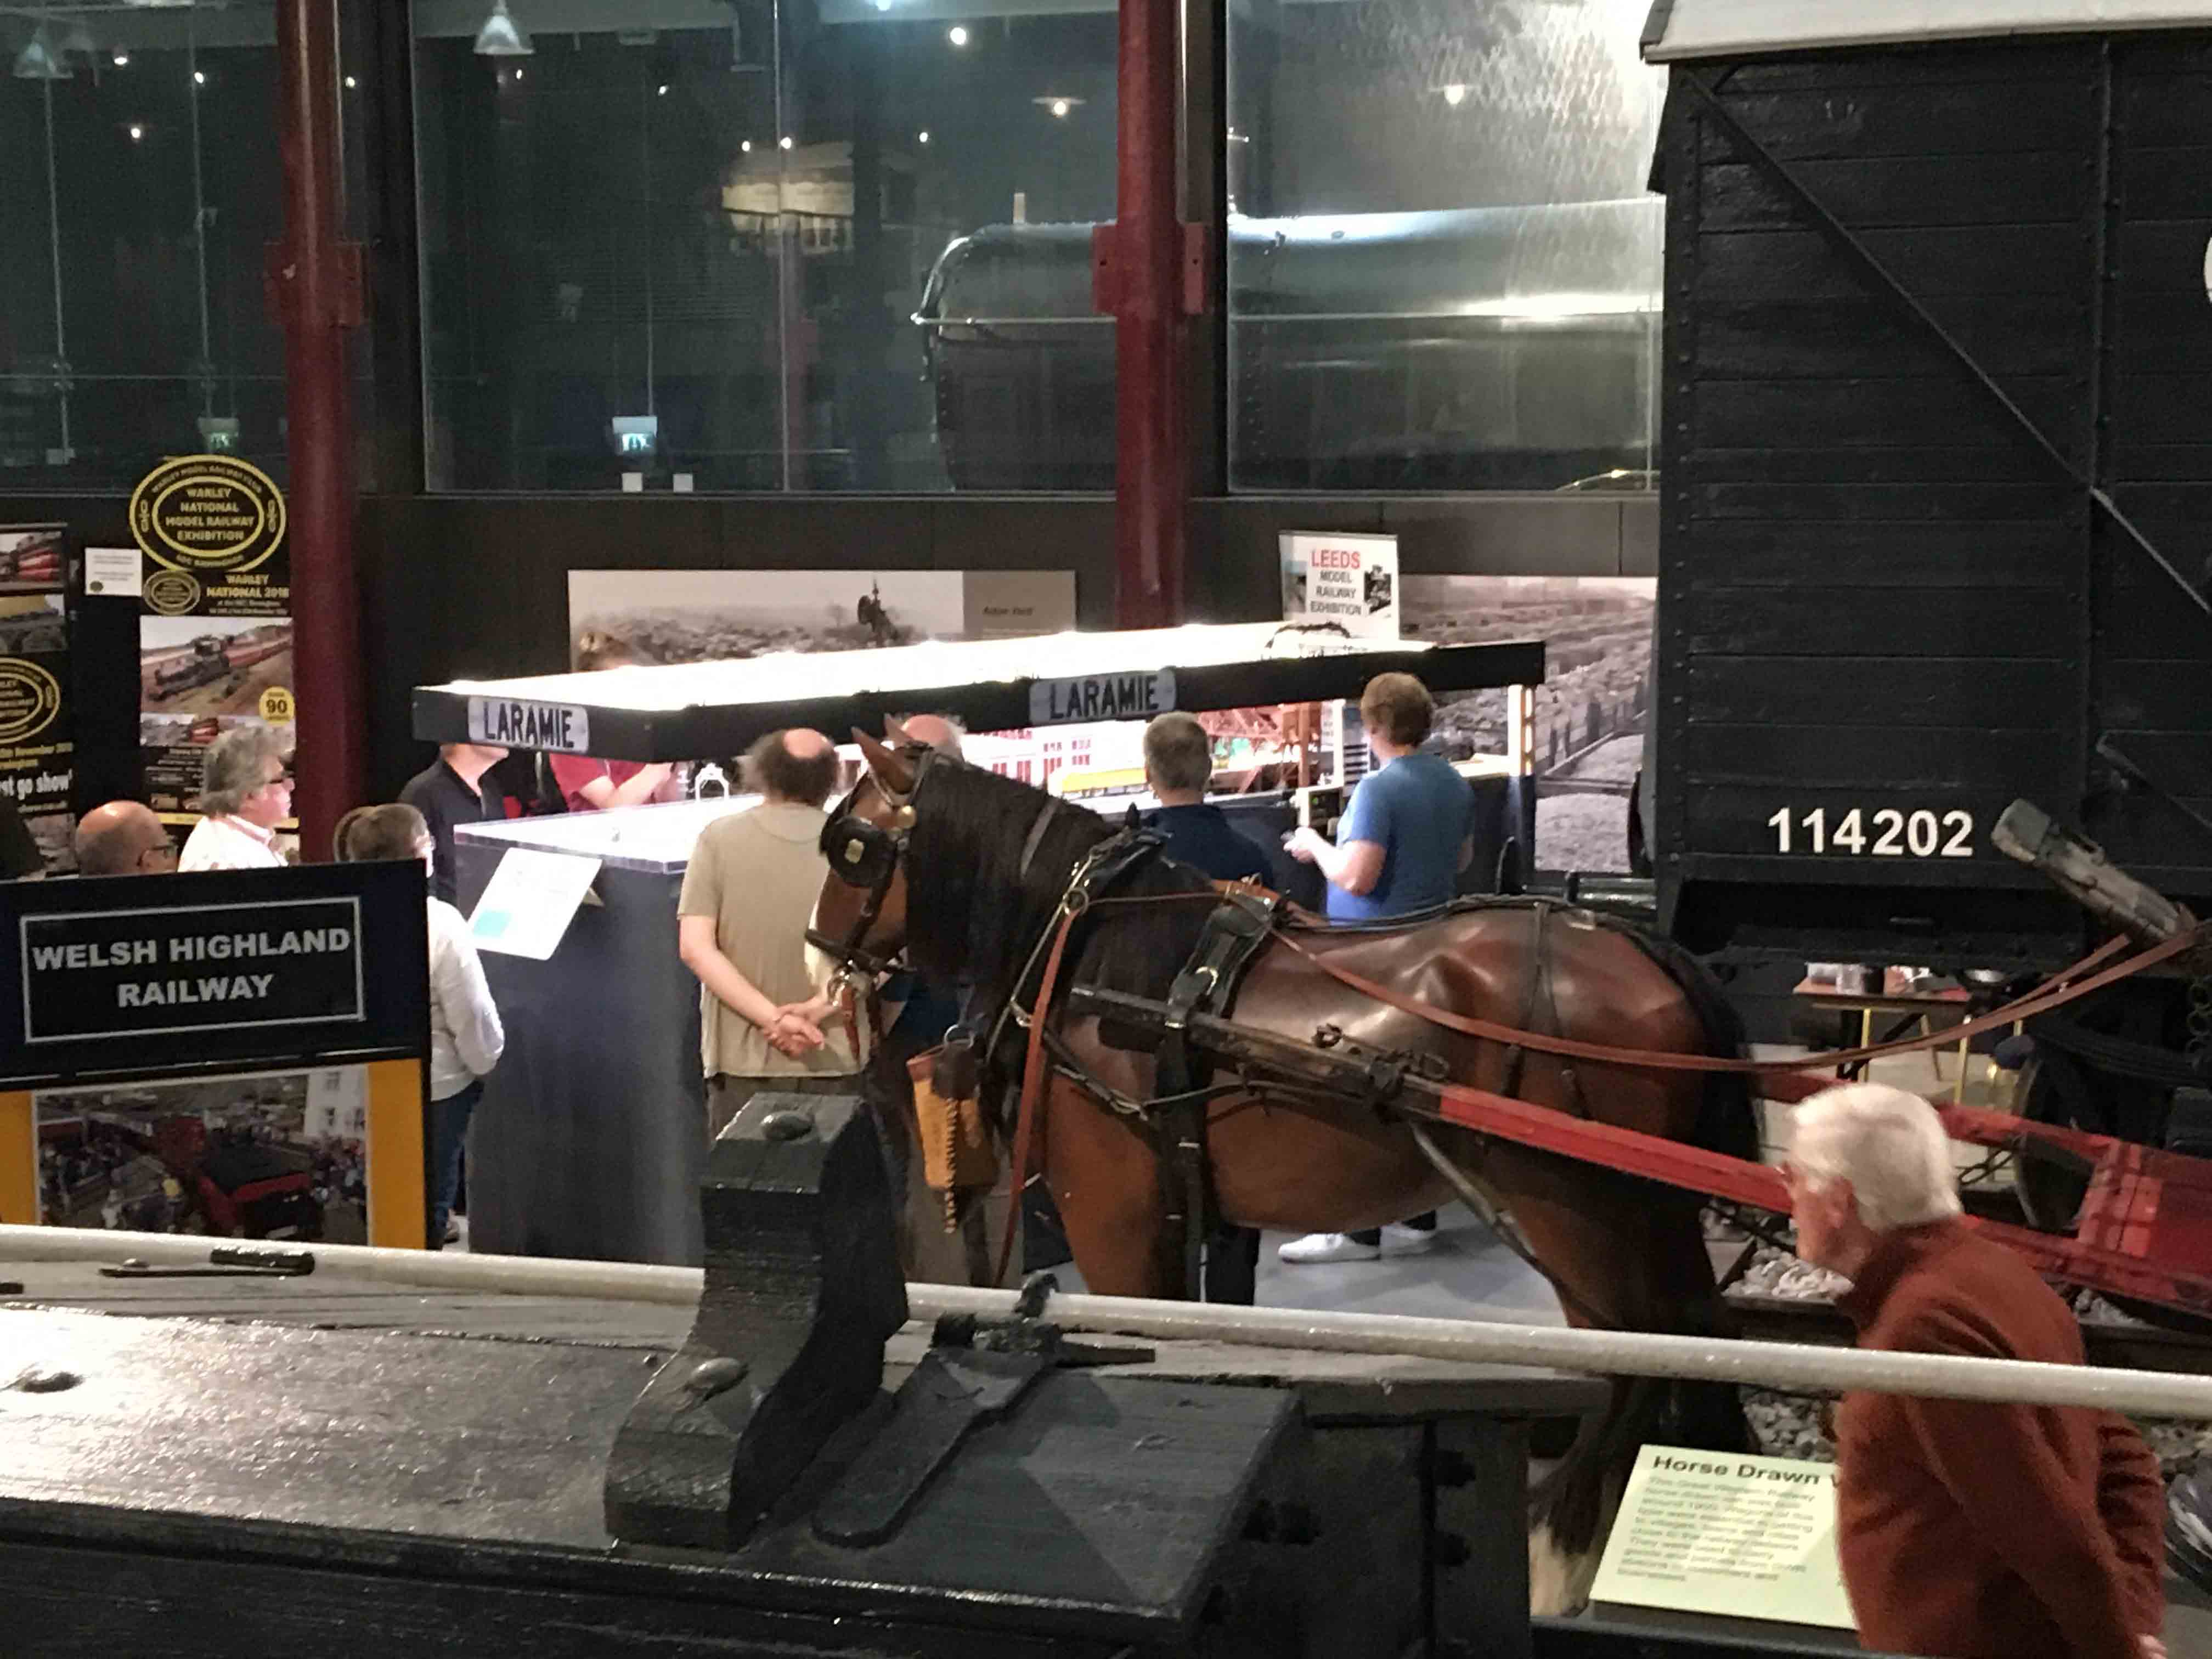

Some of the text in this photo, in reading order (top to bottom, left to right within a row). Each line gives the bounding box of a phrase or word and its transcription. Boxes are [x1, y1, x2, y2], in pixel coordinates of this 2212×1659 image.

[180, 502, 240, 512] NATIONAL
[165, 516, 255, 526] MODEL RAILWAY
[177, 531, 244, 540] EXHIBITION
[1311, 549, 1361, 569] LEEDS
[1319, 571, 1352, 584] MODEL
[206, 587, 262, 597] NATIONAL
[1317, 585, 1357, 599] RAILWAY
[1310, 601, 1362, 615] EXHIBITION
[1050, 675, 1158, 719] LARAMIE
[266, 699, 287, 713] 90
[483, 701, 574, 748] LARAMIE
[1768, 808, 1973, 857] 114202
[33, 927, 351, 971] WELSH HIGHLAND
[117, 974, 275, 1007] RAILWAY
[1653, 1455, 1729, 1476] Horse
[1737, 1464, 1820, 1486] Drawn
